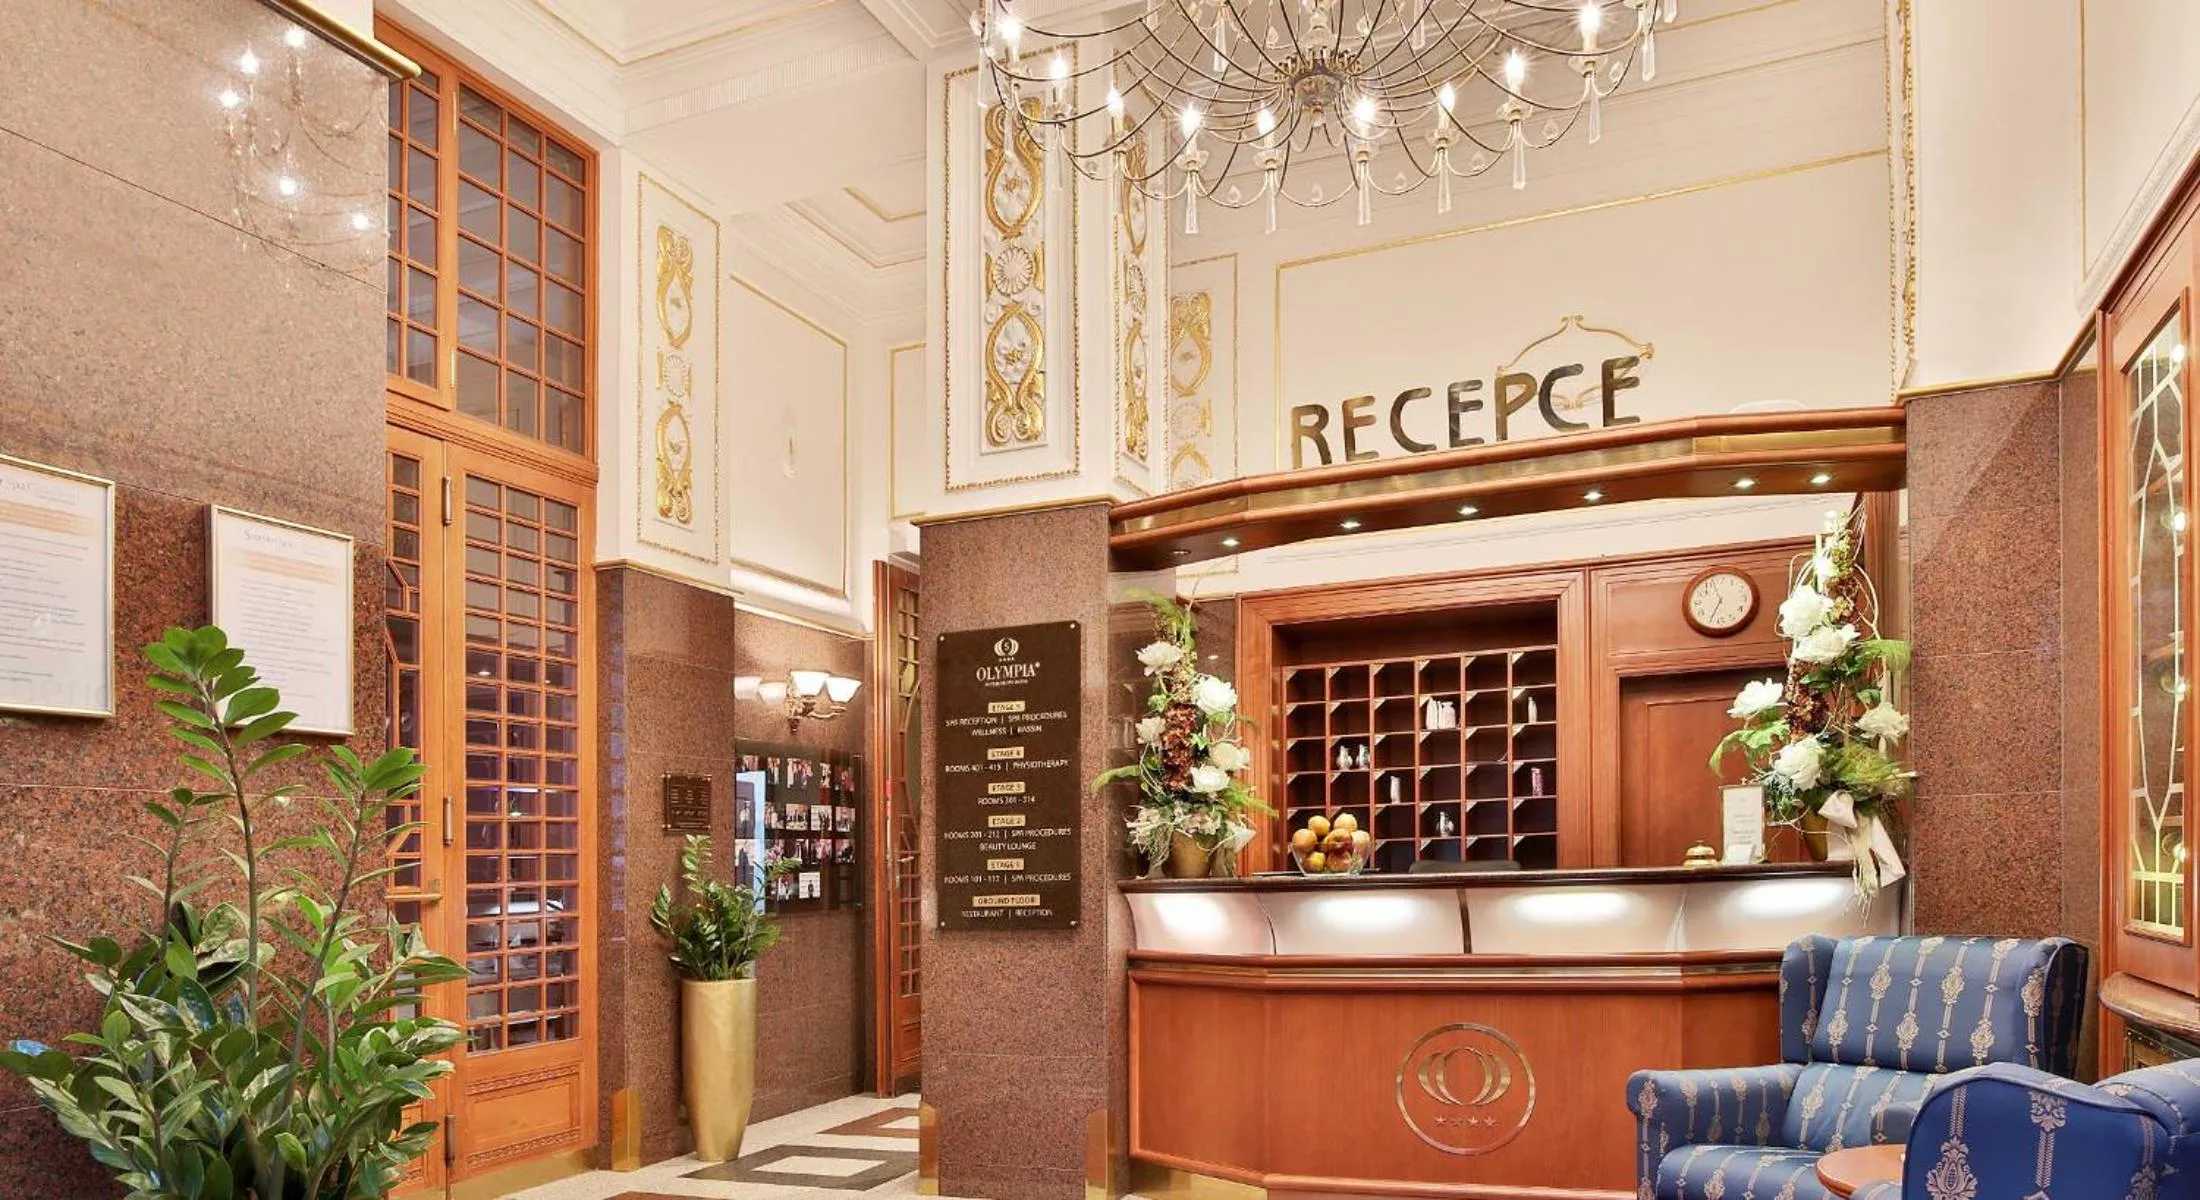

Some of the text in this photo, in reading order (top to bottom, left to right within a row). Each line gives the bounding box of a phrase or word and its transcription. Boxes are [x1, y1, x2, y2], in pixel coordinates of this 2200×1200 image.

[1291, 356, 1641, 469] RECEPCE
[976, 664, 1036, 681] OLYMPIA
[960, 716, 997, 726] RECEPTION
[1021, 711, 1068, 721] PROCEDURES
[971, 727, 1007, 736] WELLNESS
[945, 764, 970, 773] ROOMS
[1013, 759, 1069, 770] PHYSIOTHERAPY
[978, 797, 1003, 805] ROOMS
[944, 831, 969, 840] ROOMS
[1011, 829, 1024, 837] SPA
[1025, 828, 1072, 837] PROCEDURES
[979, 841, 1037, 851] BEAUTY LOUNGE
[944, 876, 969, 884] ROOMS
[1011, 874, 1025, 882] SPA
[1025, 872, 1072, 882] PROCEDURES
[978, 896, 1035, 905] GROUND FLOOR
[961, 908, 1053, 918] RESTAURANT RECEPTION
